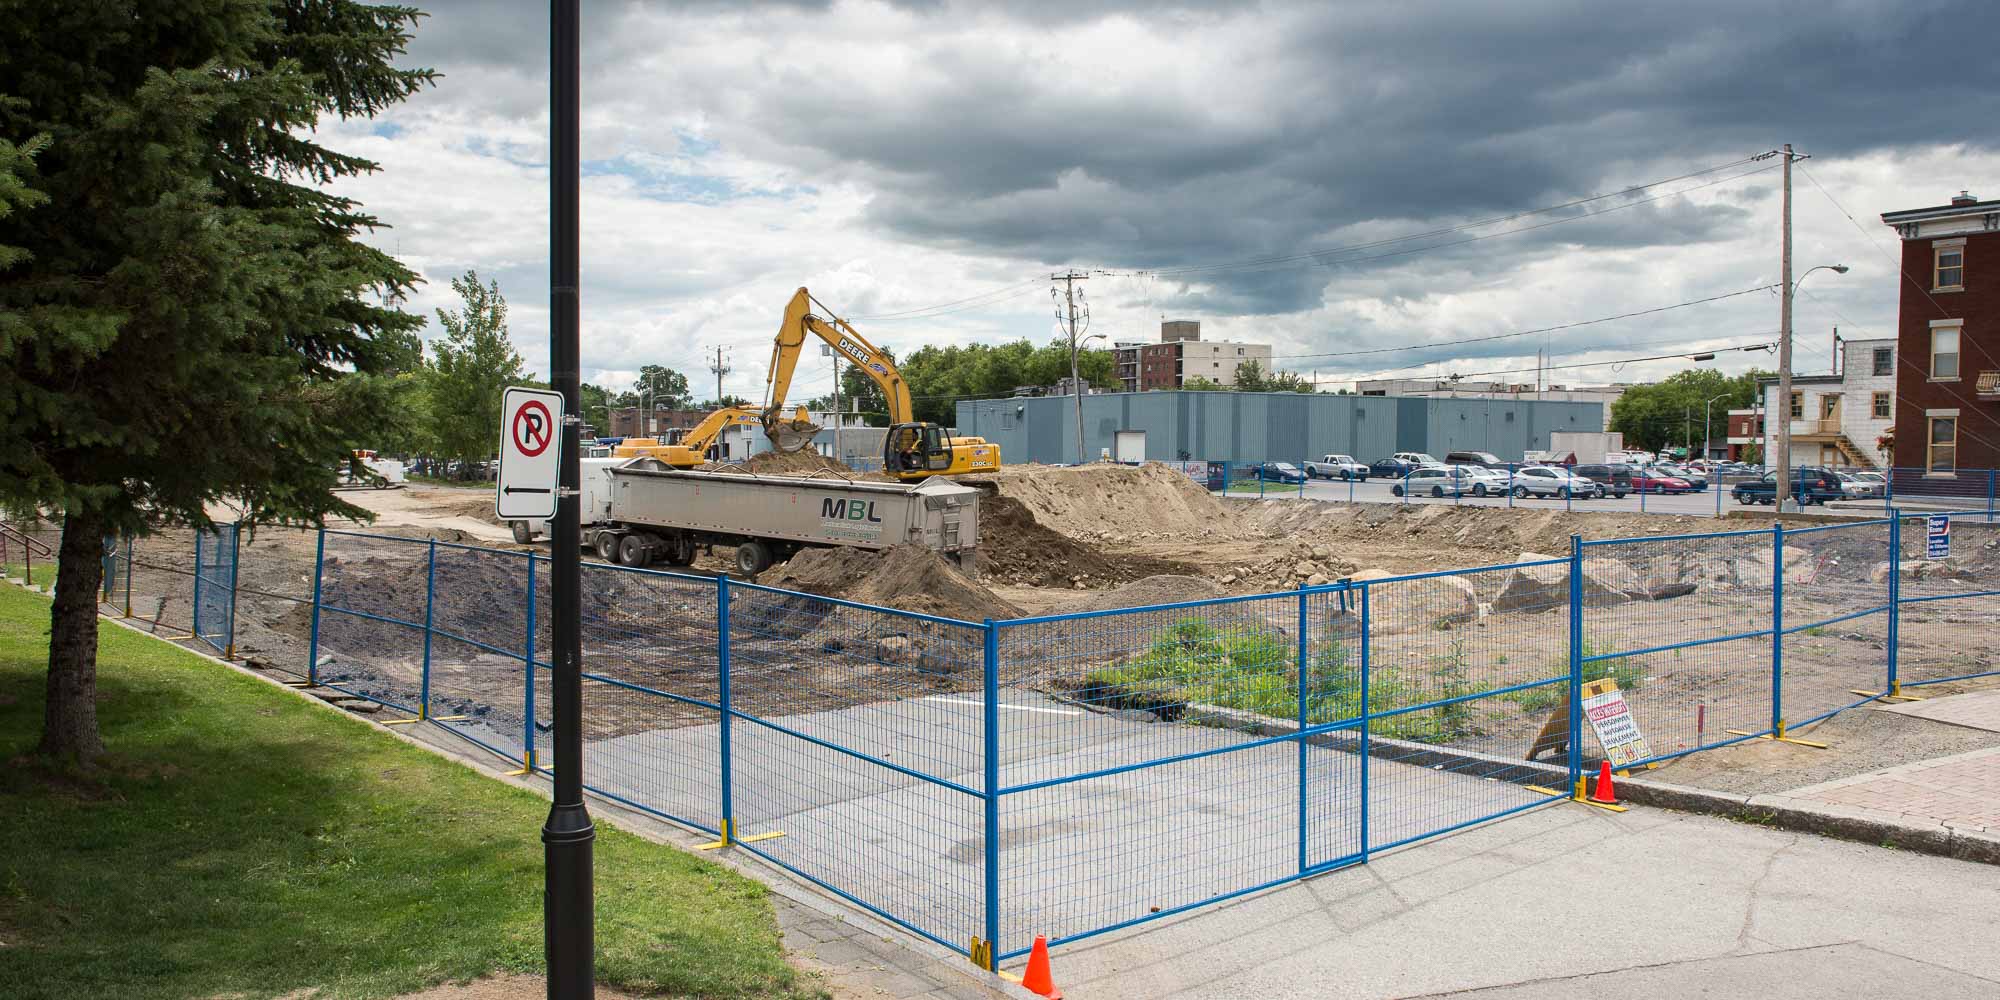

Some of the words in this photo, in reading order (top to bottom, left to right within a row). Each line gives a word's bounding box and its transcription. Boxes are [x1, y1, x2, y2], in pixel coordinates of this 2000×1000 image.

[839, 338, 870, 364] DEERE
[821, 497, 882, 523] MBL
[1930, 519, 1944, 527] Super
[1604, 731, 1638, 745] SEULEMENT
